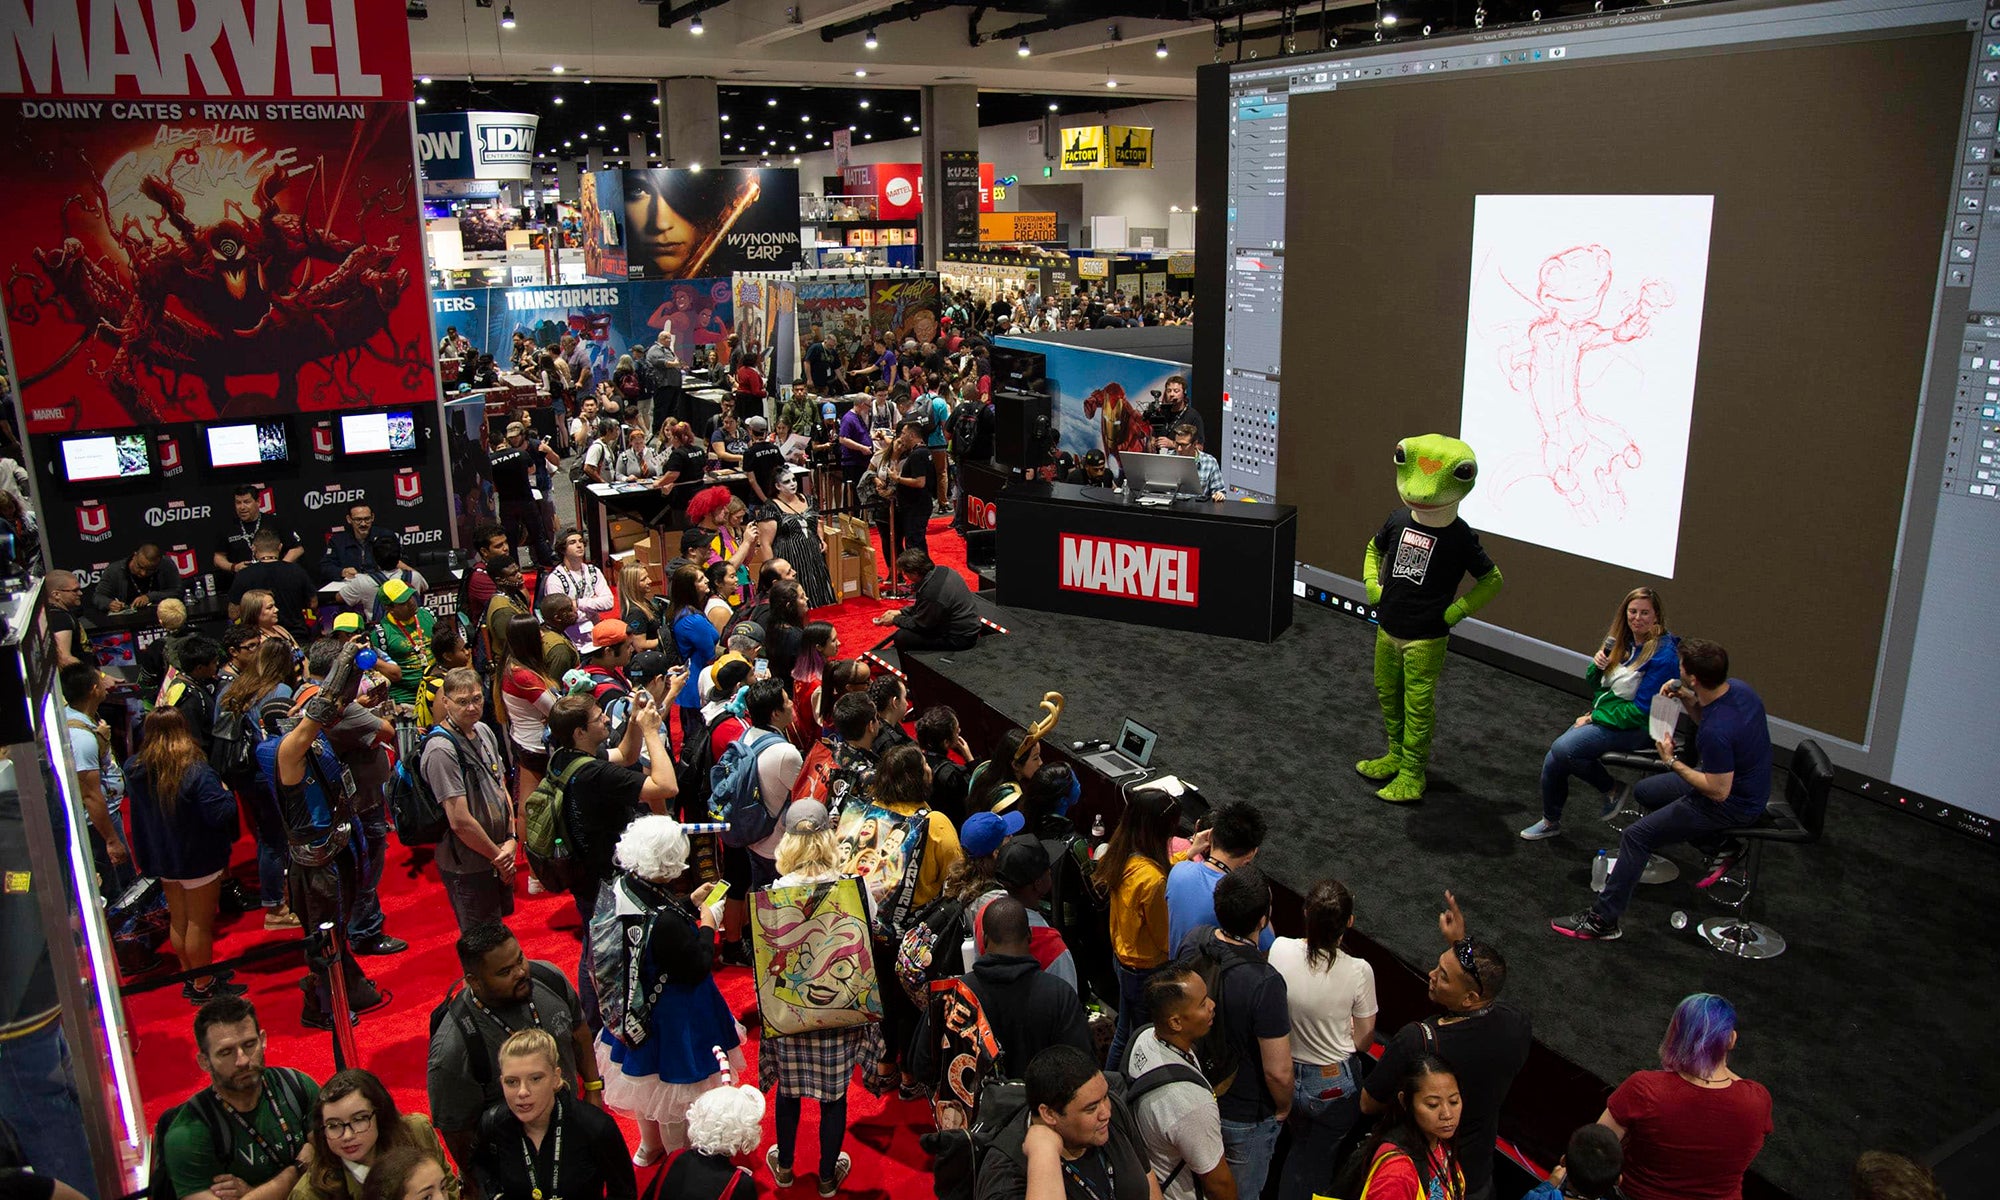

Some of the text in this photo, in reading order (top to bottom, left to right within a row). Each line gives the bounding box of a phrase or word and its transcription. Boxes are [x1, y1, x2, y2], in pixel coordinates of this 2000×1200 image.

[0, 0, 382, 96] MARVEL
[22, 103, 366, 120] DONNY CATES RYAN STEGMAN
[152, 124, 255, 149] ABSOLUTE
[486, 128, 534, 151] IDW
[1065, 149, 1097, 161] FACTORY
[1116, 149, 1146, 160] FACTORY
[843, 167, 871, 187] MATTEL
[886, 185, 912, 199] MATTEL
[727, 232, 800, 248] WYNONNA
[1014, 230, 1056, 241] CREATOR
[746, 246, 783, 261] EARP
[629, 265, 643, 273] IDW
[513, 275, 534, 285] IDW
[433, 297, 476, 312] TERS
[505, 288, 619, 311] TRANSFORMERS
[32, 408, 65, 421] MARVEL
[490, 451, 521, 465] STAFF
[304, 489, 365, 510] INSIDER
[145, 506, 211, 527] INSIDER
[81, 531, 113, 542] UNLIMITED
[1403, 531, 1430, 550] MARVEL
[1063, 537, 1194, 602] MARVEL
[1393, 563, 1425, 577] YEARS
